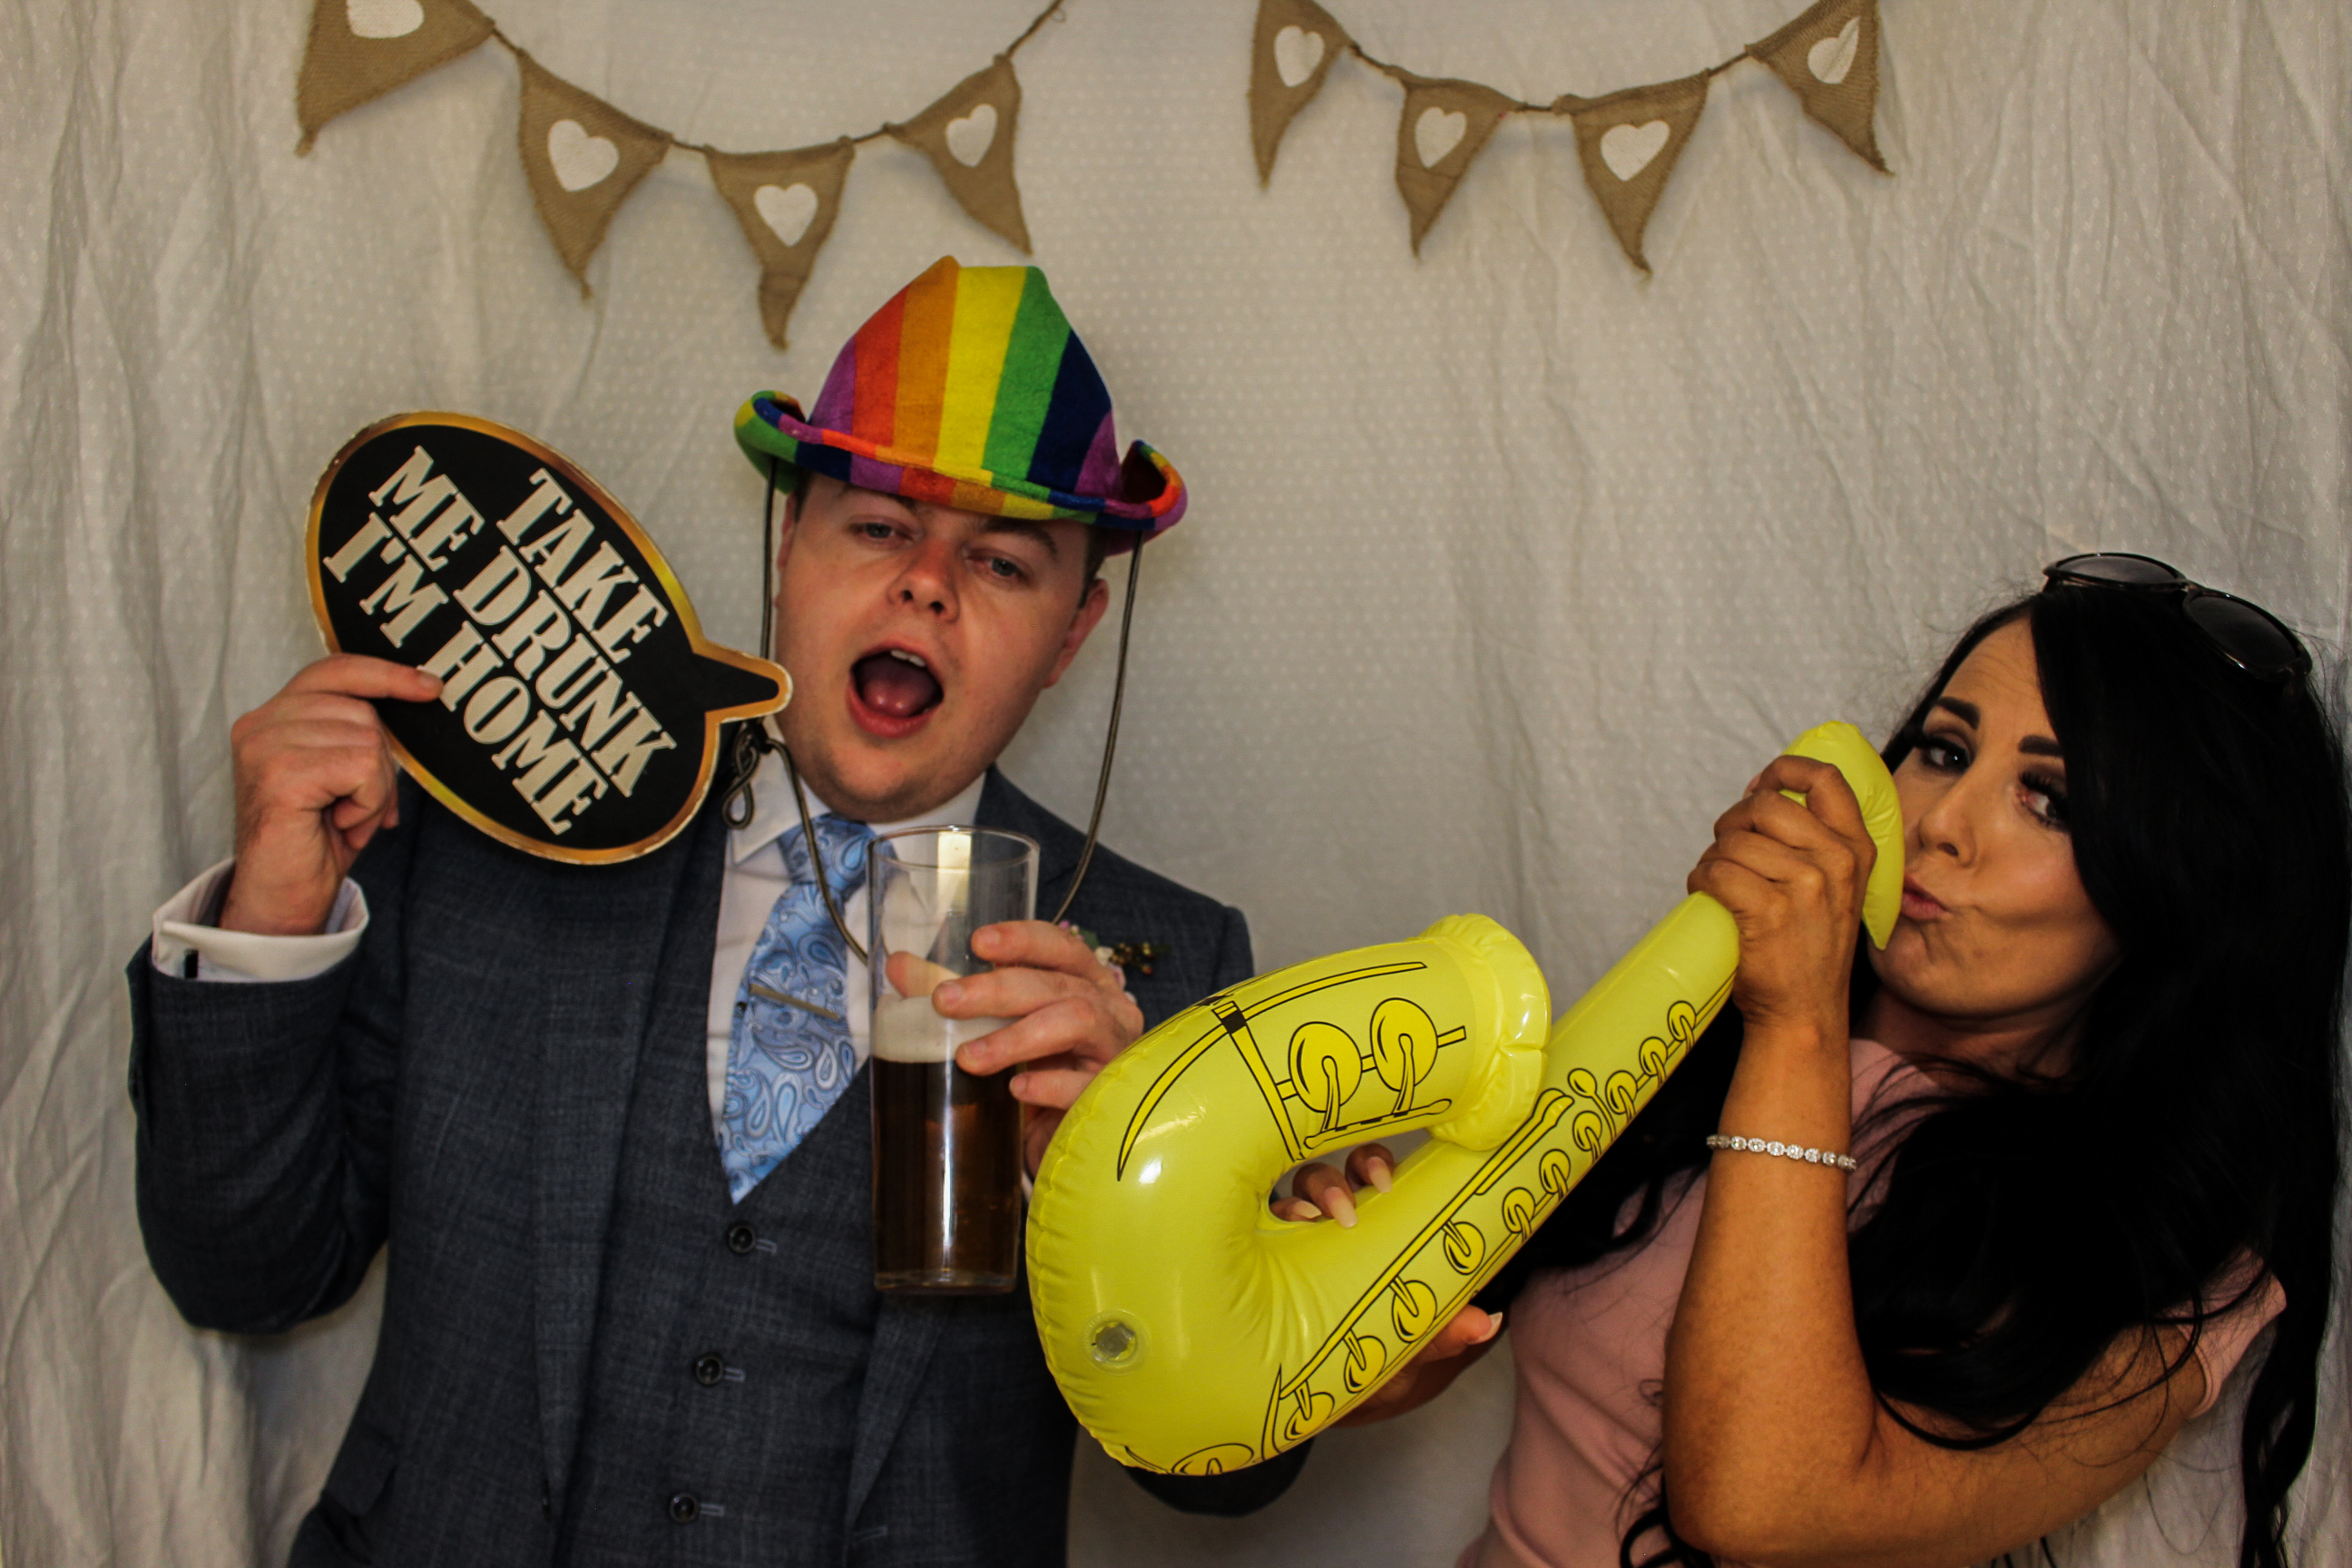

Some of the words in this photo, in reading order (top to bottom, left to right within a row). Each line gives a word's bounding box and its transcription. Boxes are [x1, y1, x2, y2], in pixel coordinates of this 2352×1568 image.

[323, 512, 449, 649] I'M
[416, 621, 609, 836] HOME
[368, 446, 485, 572] ME
[453, 544, 677, 798] DRUNK
[495, 467, 669, 663] TAKE
